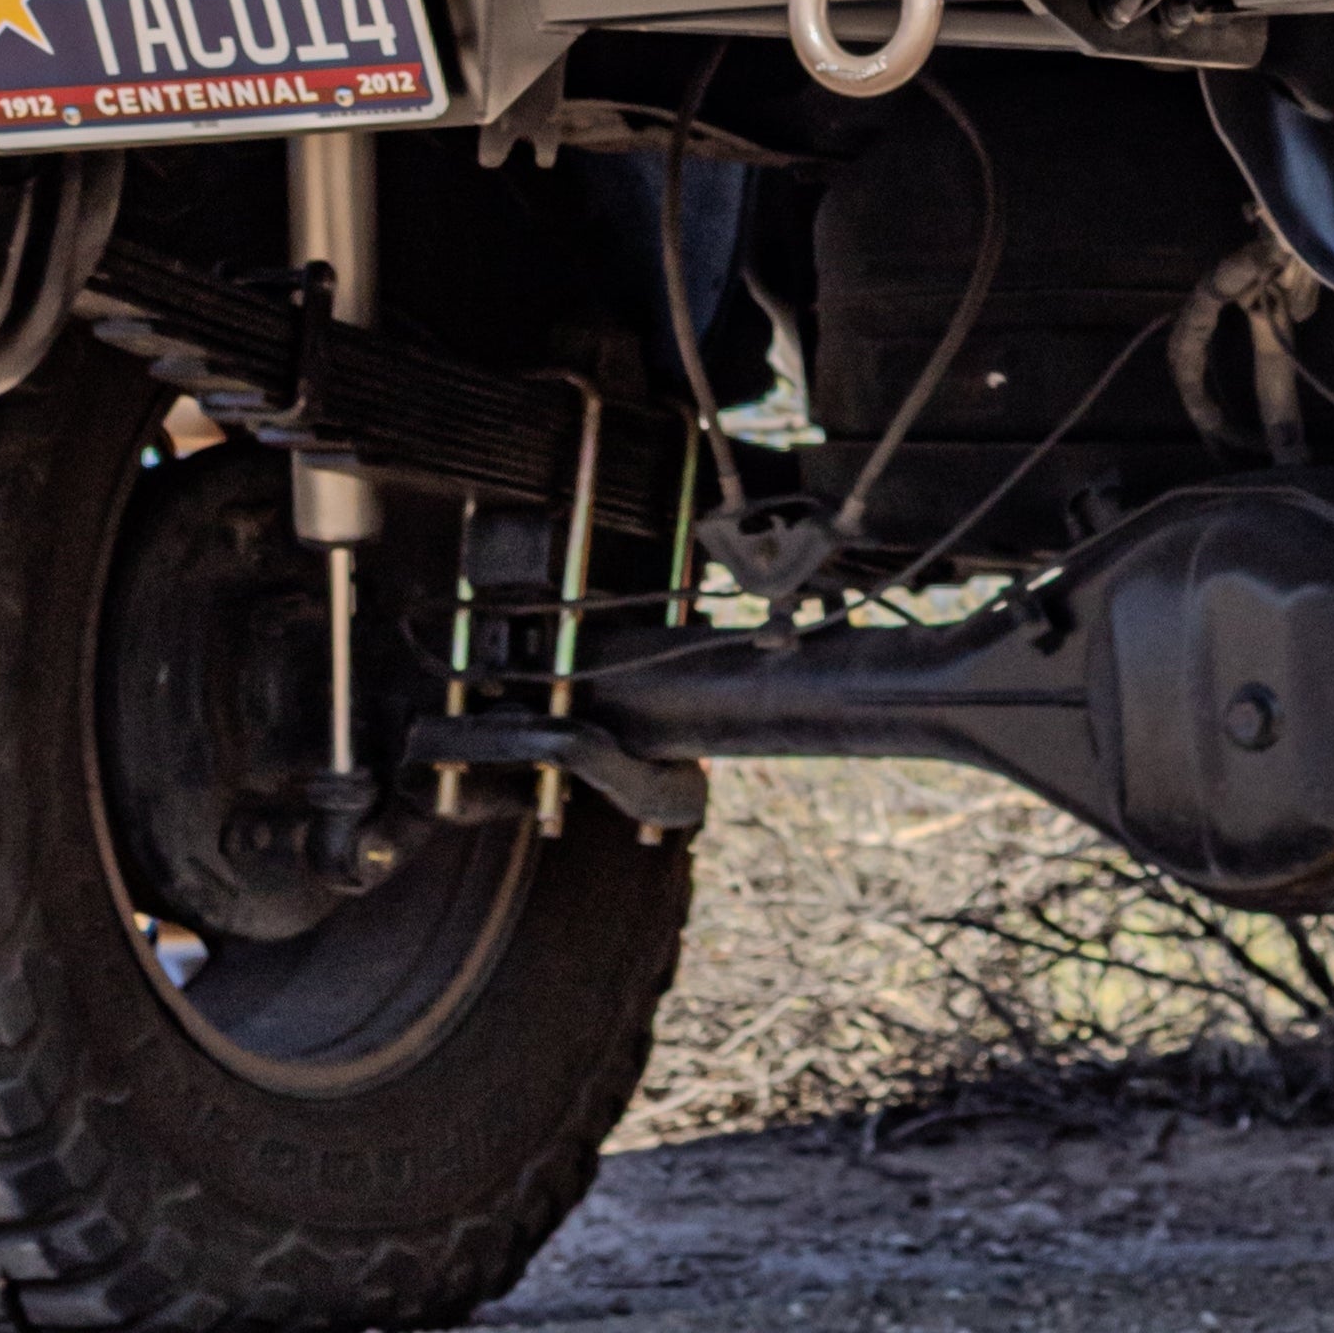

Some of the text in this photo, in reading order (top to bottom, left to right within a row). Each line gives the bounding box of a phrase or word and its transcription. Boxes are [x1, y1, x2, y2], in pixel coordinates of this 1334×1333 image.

[0, 94, 57, 119] 1912
[94, 75, 320, 117] CENTENNIAL
[356, 69, 417, 97] 2012
